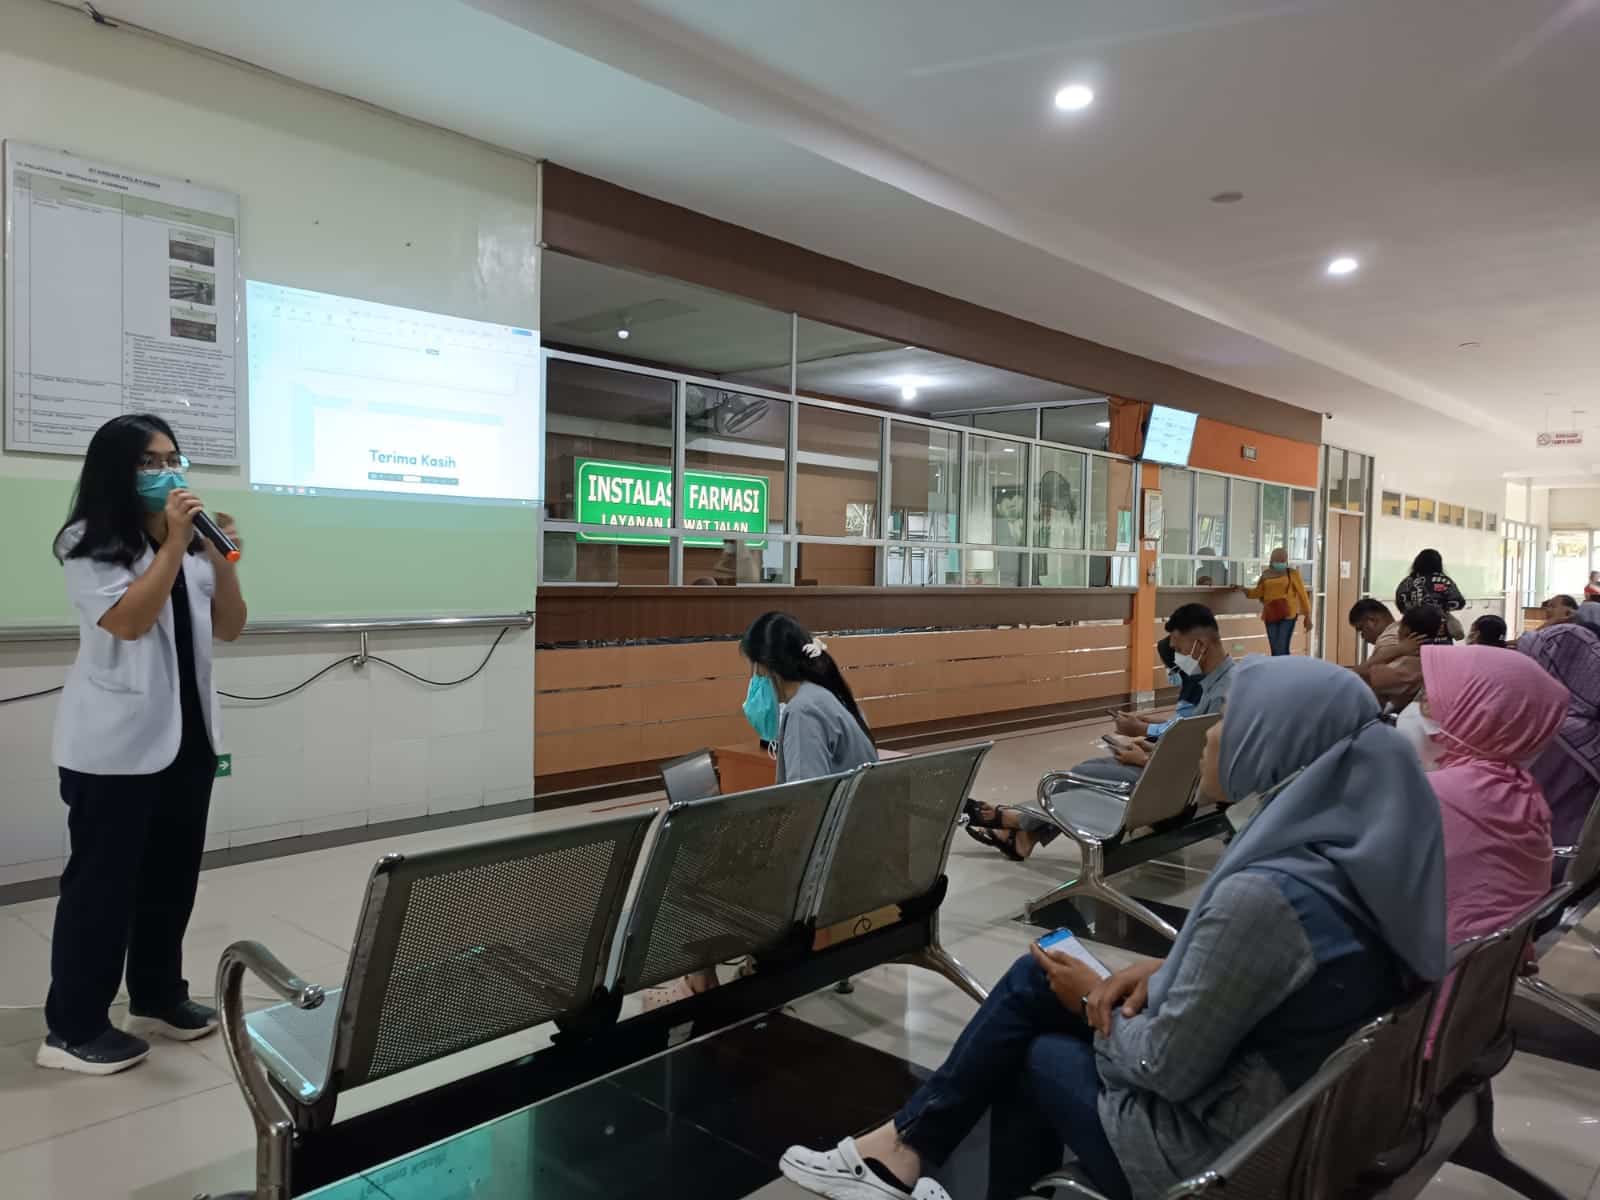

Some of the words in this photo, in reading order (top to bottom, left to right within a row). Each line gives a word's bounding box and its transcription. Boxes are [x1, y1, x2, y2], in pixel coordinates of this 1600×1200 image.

[369, 449, 417, 465] Terima
[421, 454, 457, 469] Kasih
[588, 474, 672, 507] INSTALAS
[689, 484, 760, 514] FARMASI
